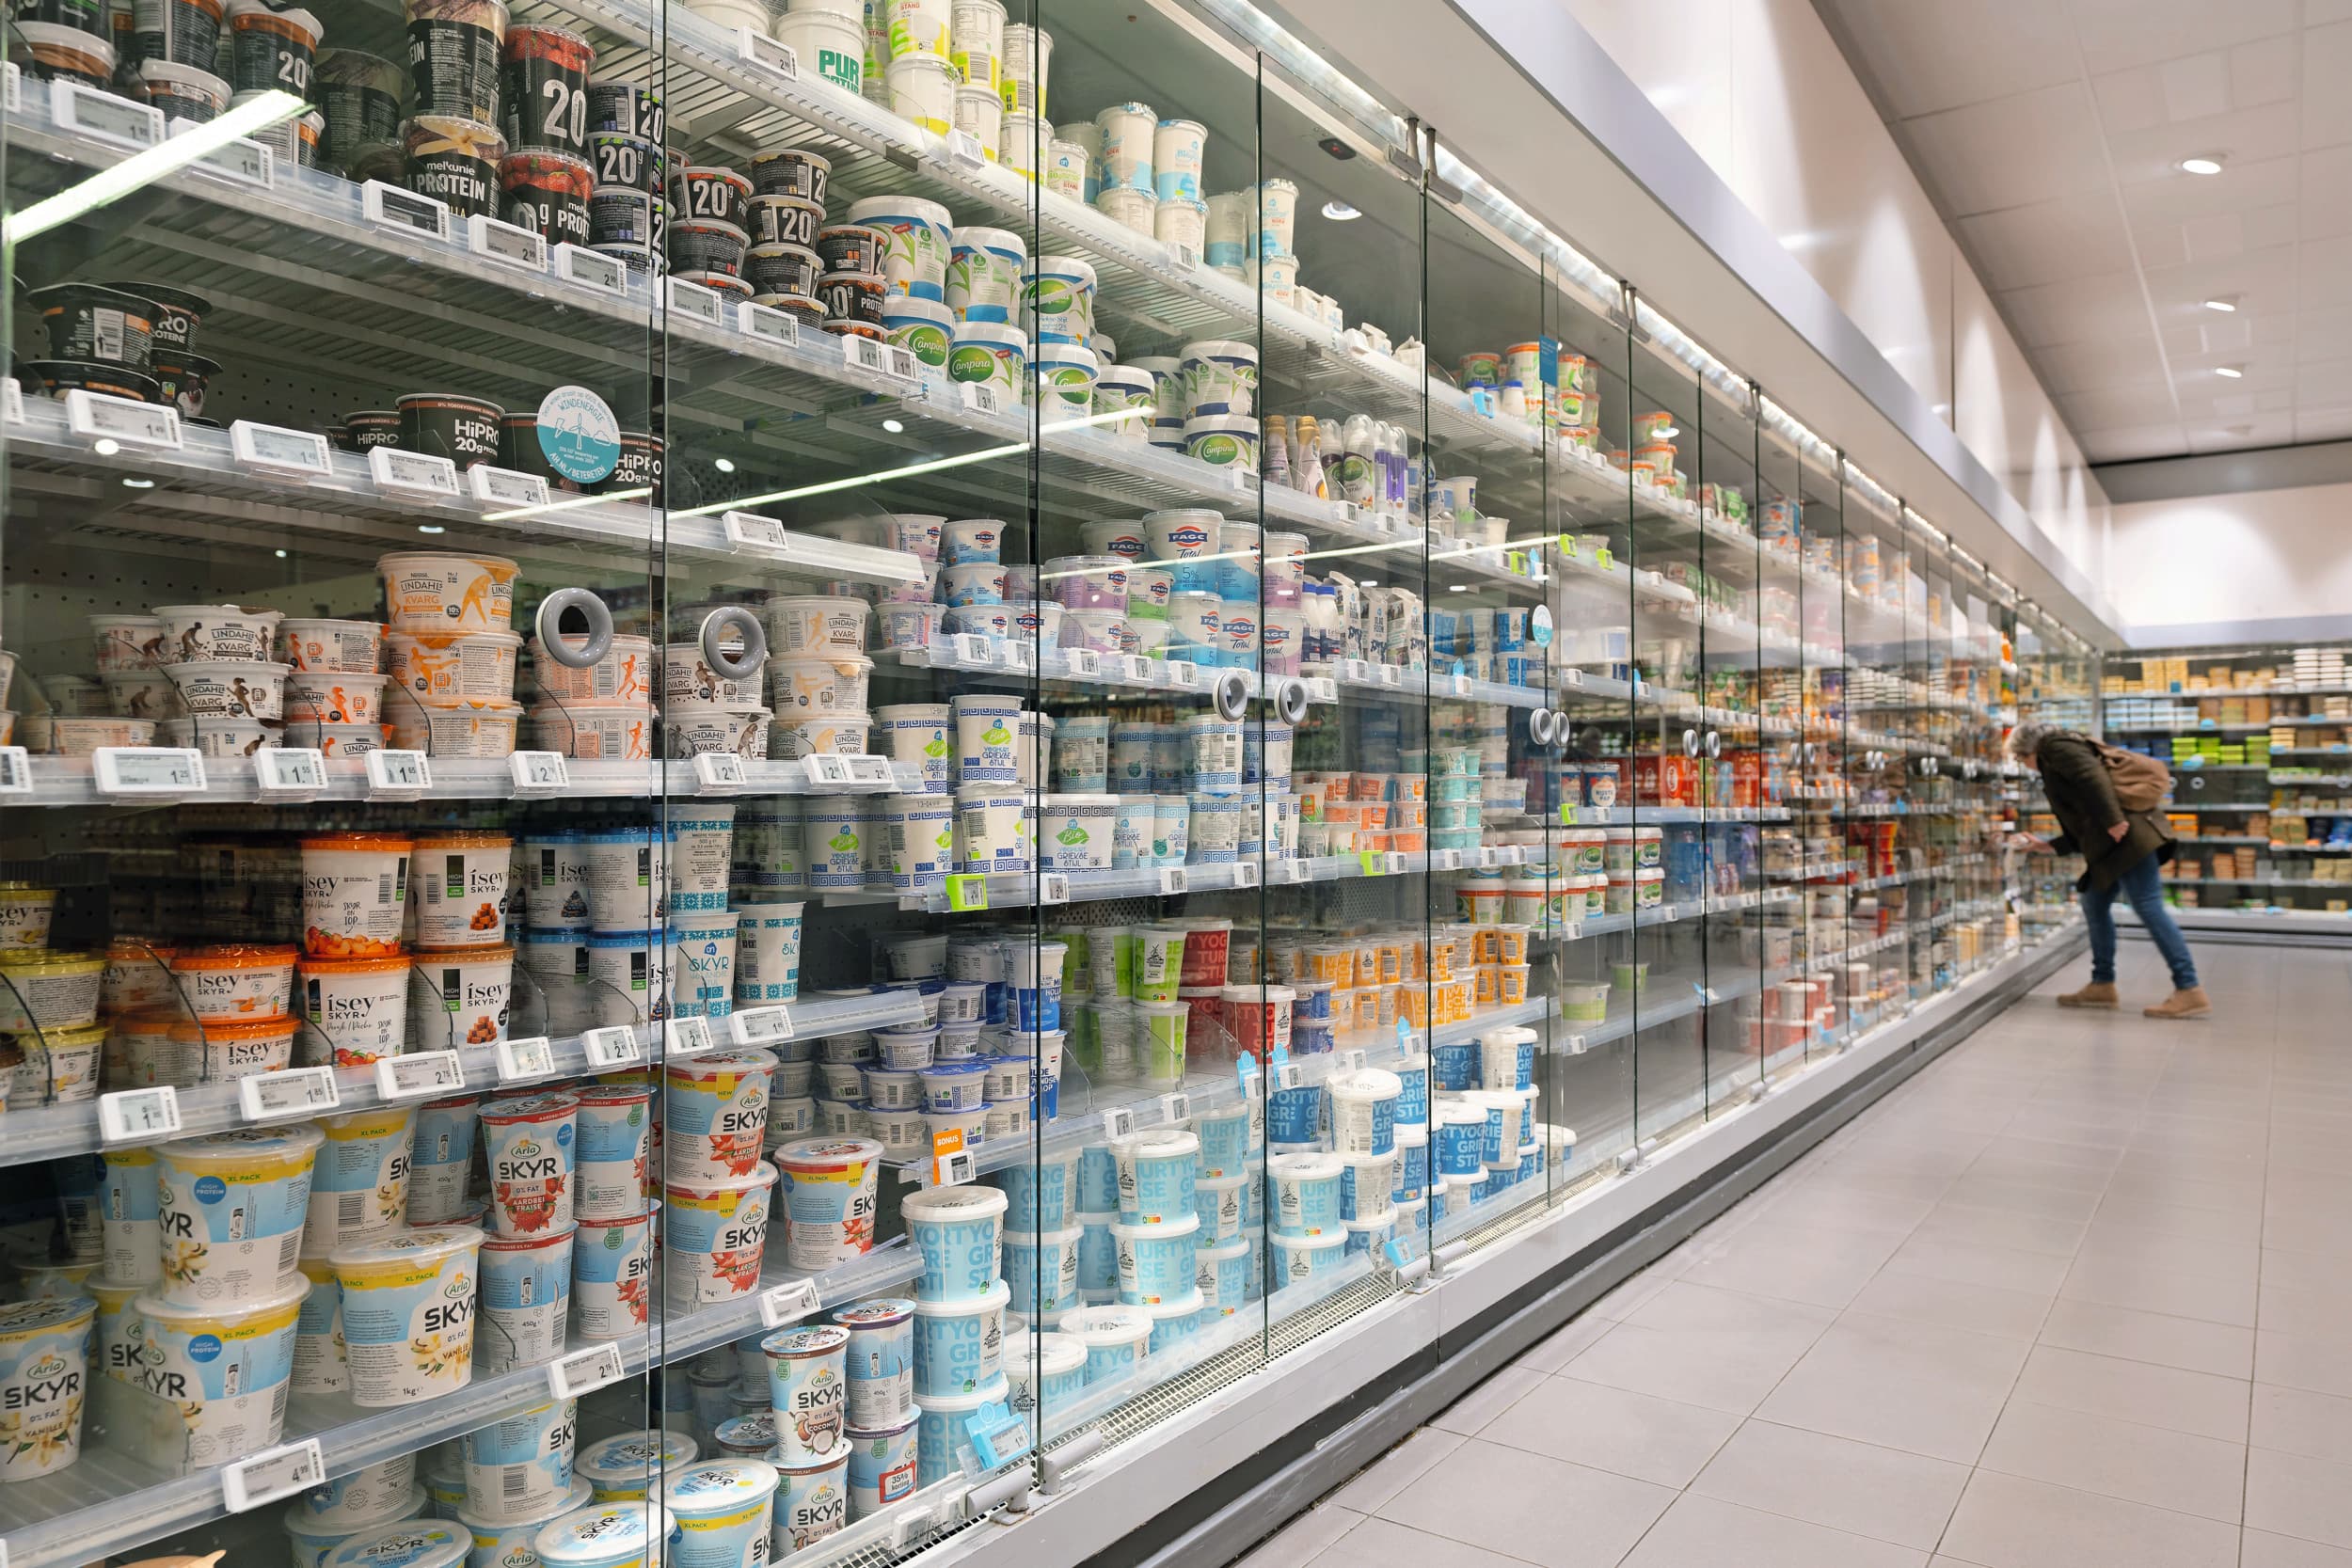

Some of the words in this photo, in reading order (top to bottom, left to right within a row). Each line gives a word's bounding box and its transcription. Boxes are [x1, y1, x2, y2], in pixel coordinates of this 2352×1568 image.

[818, 50, 859, 86] PUR
[543, 79, 587, 147] 20
[425, 160, 476, 176] melkunie
[416, 173, 485, 203] PROTEIN
[557, 209, 590, 240] PROTE
[913, 337, 946, 353] Campina
[952, 359, 992, 374] Campina
[558, 398, 606, 422] WINDENERGIE
[454, 419, 500, 446] HiPRO
[454, 436, 483, 453] 20g
[1202, 443, 1238, 461] Campina
[1170, 532, 1206, 543] FAGE
[1109, 543, 1144, 553] FAGE
[405, 595, 438, 604] KVARG
[833, 630, 856, 639] KVARG
[1224, 624, 1255, 634] FAGE
[1265, 630, 1290, 640] AGE
[216, 642, 250, 652] KVARG
[1231, 639, 1250, 650] Total
[189, 698, 222, 707] KVARG
[689, 956, 729, 972] SKYR
[468, 999, 497, 1007] SKYR
[229, 1056, 259, 1065] SKYR
[743, 1094, 761, 1106] Arla
[723, 1109, 768, 1132] SKYR
[937, 1134, 960, 1147] BONUS
[500, 1158, 557, 1180] SKYR
[512, 1196, 545, 1206] AARDBEI
[853, 1191, 876, 1216] SKY
[744, 1212, 762, 1223] Arla
[448, 1279, 469, 1296] Arla
[457, 1330, 467, 1339] FAT
[30, 1362, 62, 1378] Arla
[813, 1373, 832, 1386] Arla
[5, 1372, 80, 1407] SKYR
[403, 1386, 417, 1396] 1kg
[798, 1383, 843, 1407] SKYR
[44, 1409, 61, 1420] FAT
[808, 1420, 836, 1432] COCONUT
[812, 1489, 833, 1504] Arla
[798, 1498, 843, 1523] SKYR
[506, 1553, 532, 1567] Arla
